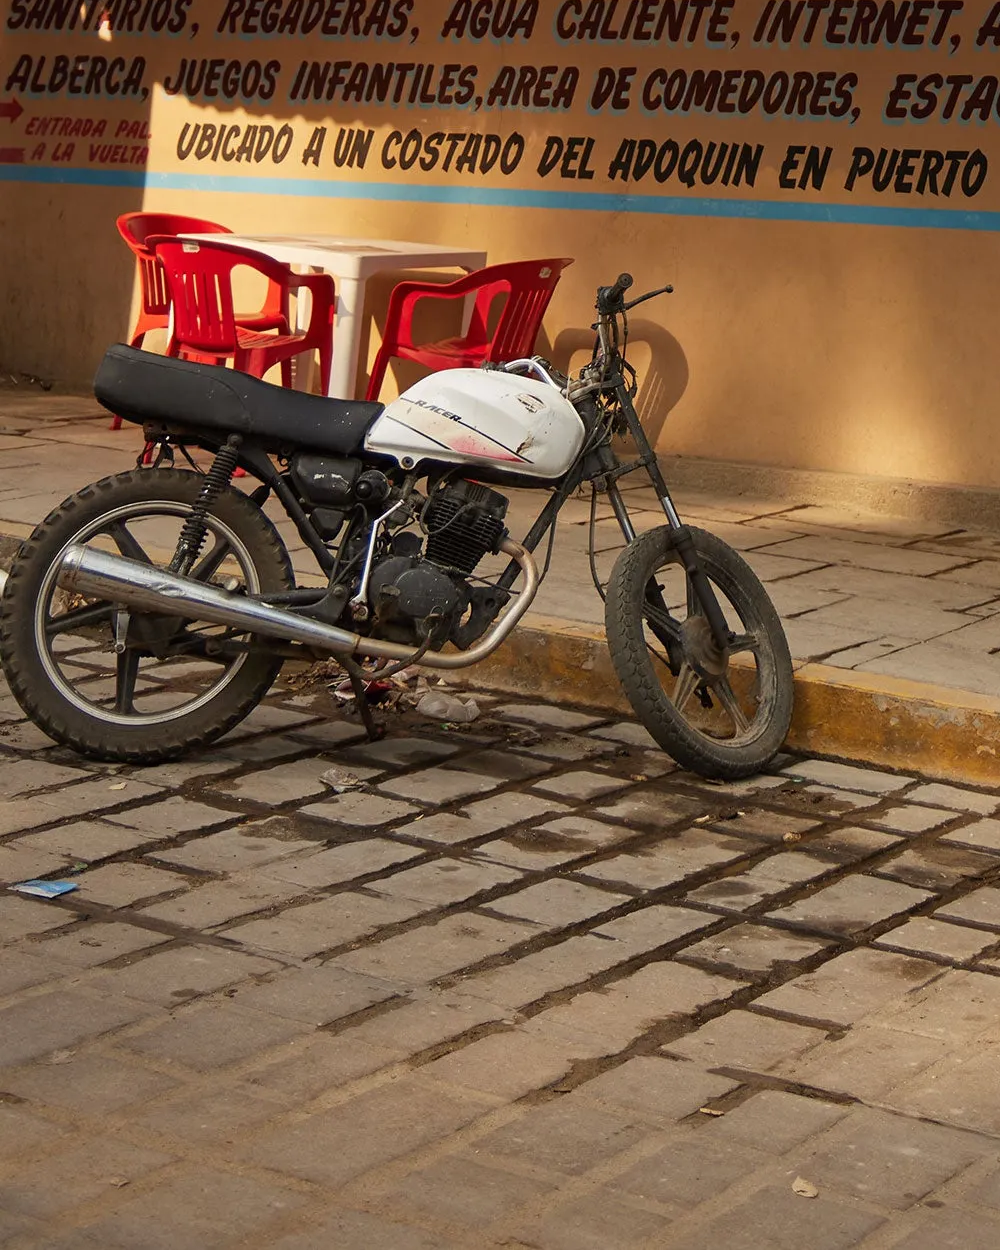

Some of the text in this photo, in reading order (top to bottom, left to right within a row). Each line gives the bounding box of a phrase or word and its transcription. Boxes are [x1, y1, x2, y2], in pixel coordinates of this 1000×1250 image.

[753, 0, 963, 55] INTERNET,
[5, 54, 149, 101] ALBERCA,
[164, 58, 281, 100] JUEGOS
[290, 61, 483, 113] INFANTILES,
[488, 65, 578, 108] AREA
[592, 66, 635, 110] DE
[642, 66, 861, 124] COMEDORES,
[25, 116, 107, 137] ENTRADA
[31, 143, 149, 164] A LA VUELTA
[176, 123, 293, 164] UBICADO
[302, 127, 328, 166] A
[332, 130, 374, 168] UN
[382, 131, 525, 174] COSTADO
[537, 137, 596, 180] DEL
[608, 137, 765, 188] ADOQUIN
[779, 144, 831, 190] EN
[844, 145, 989, 198] PUERTO
[414, 400, 461, 422] RACER
